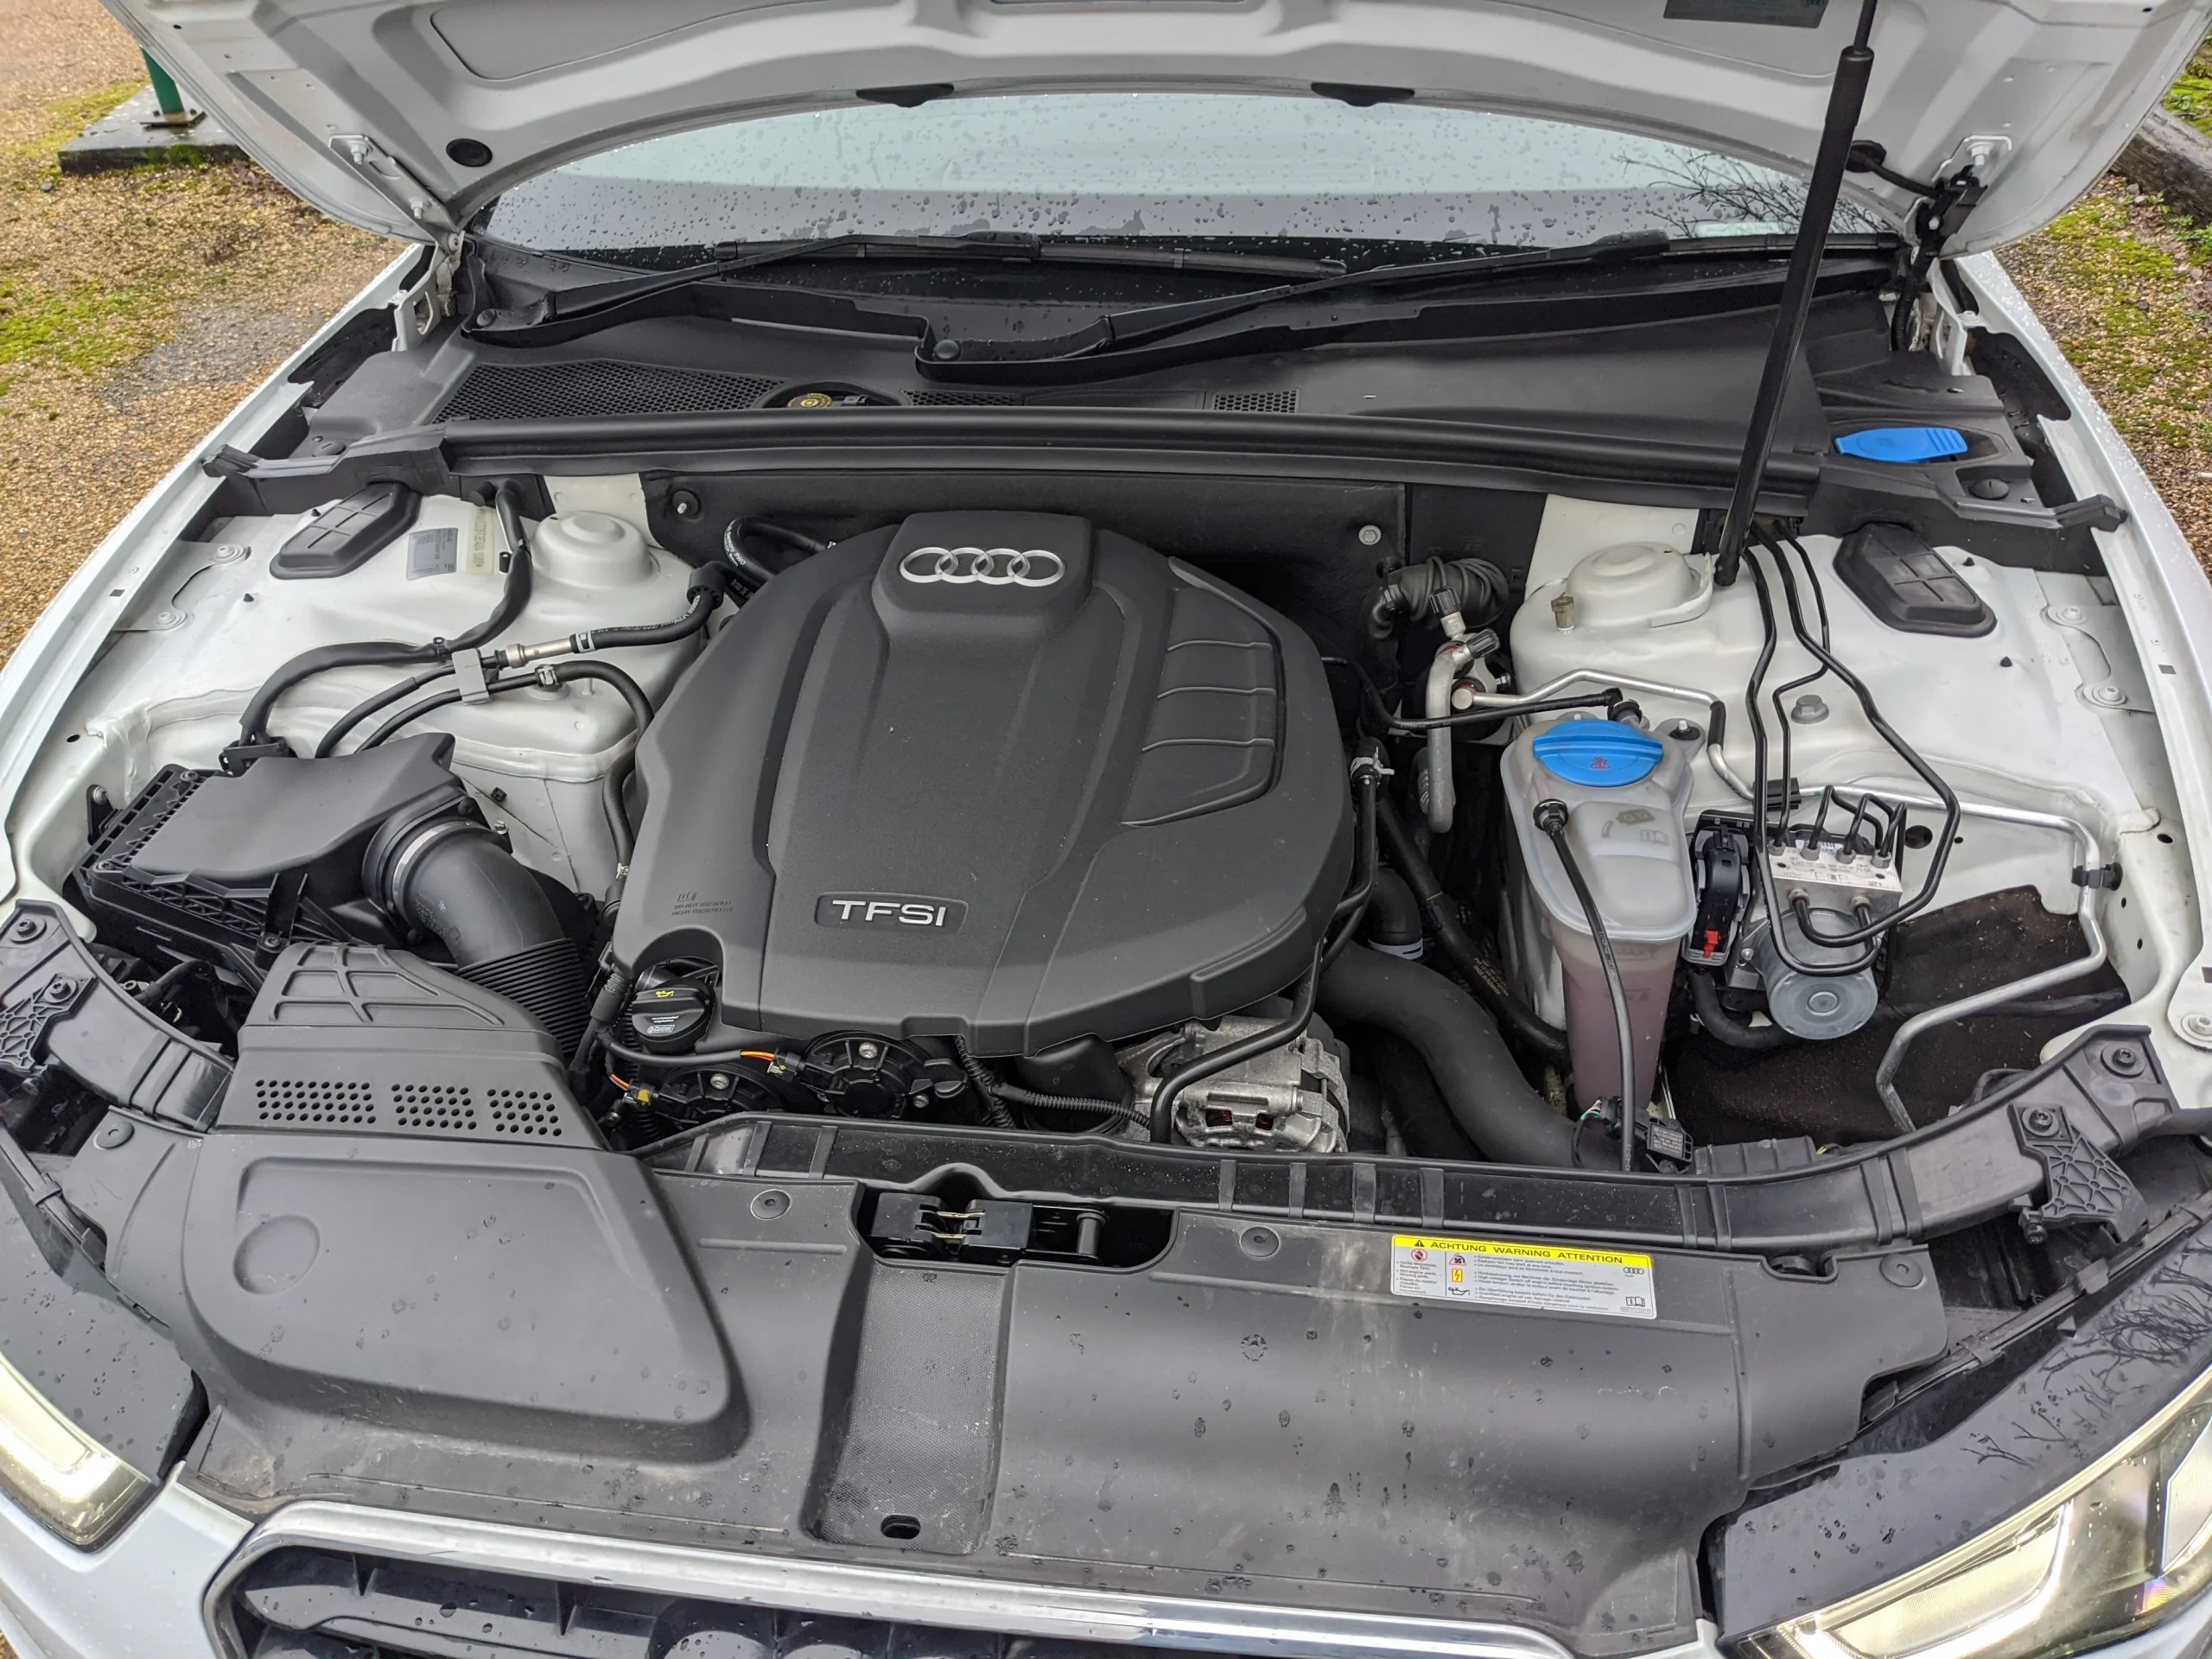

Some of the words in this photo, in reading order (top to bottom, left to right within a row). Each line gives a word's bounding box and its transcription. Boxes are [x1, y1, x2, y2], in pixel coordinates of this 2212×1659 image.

[832, 899, 947, 927] TFSI
[1431, 1242, 1487, 1252] ACHTUNG
[1493, 1247, 1551, 1258] WARNING
[1558, 1252, 1623, 1263] ATTENTION
